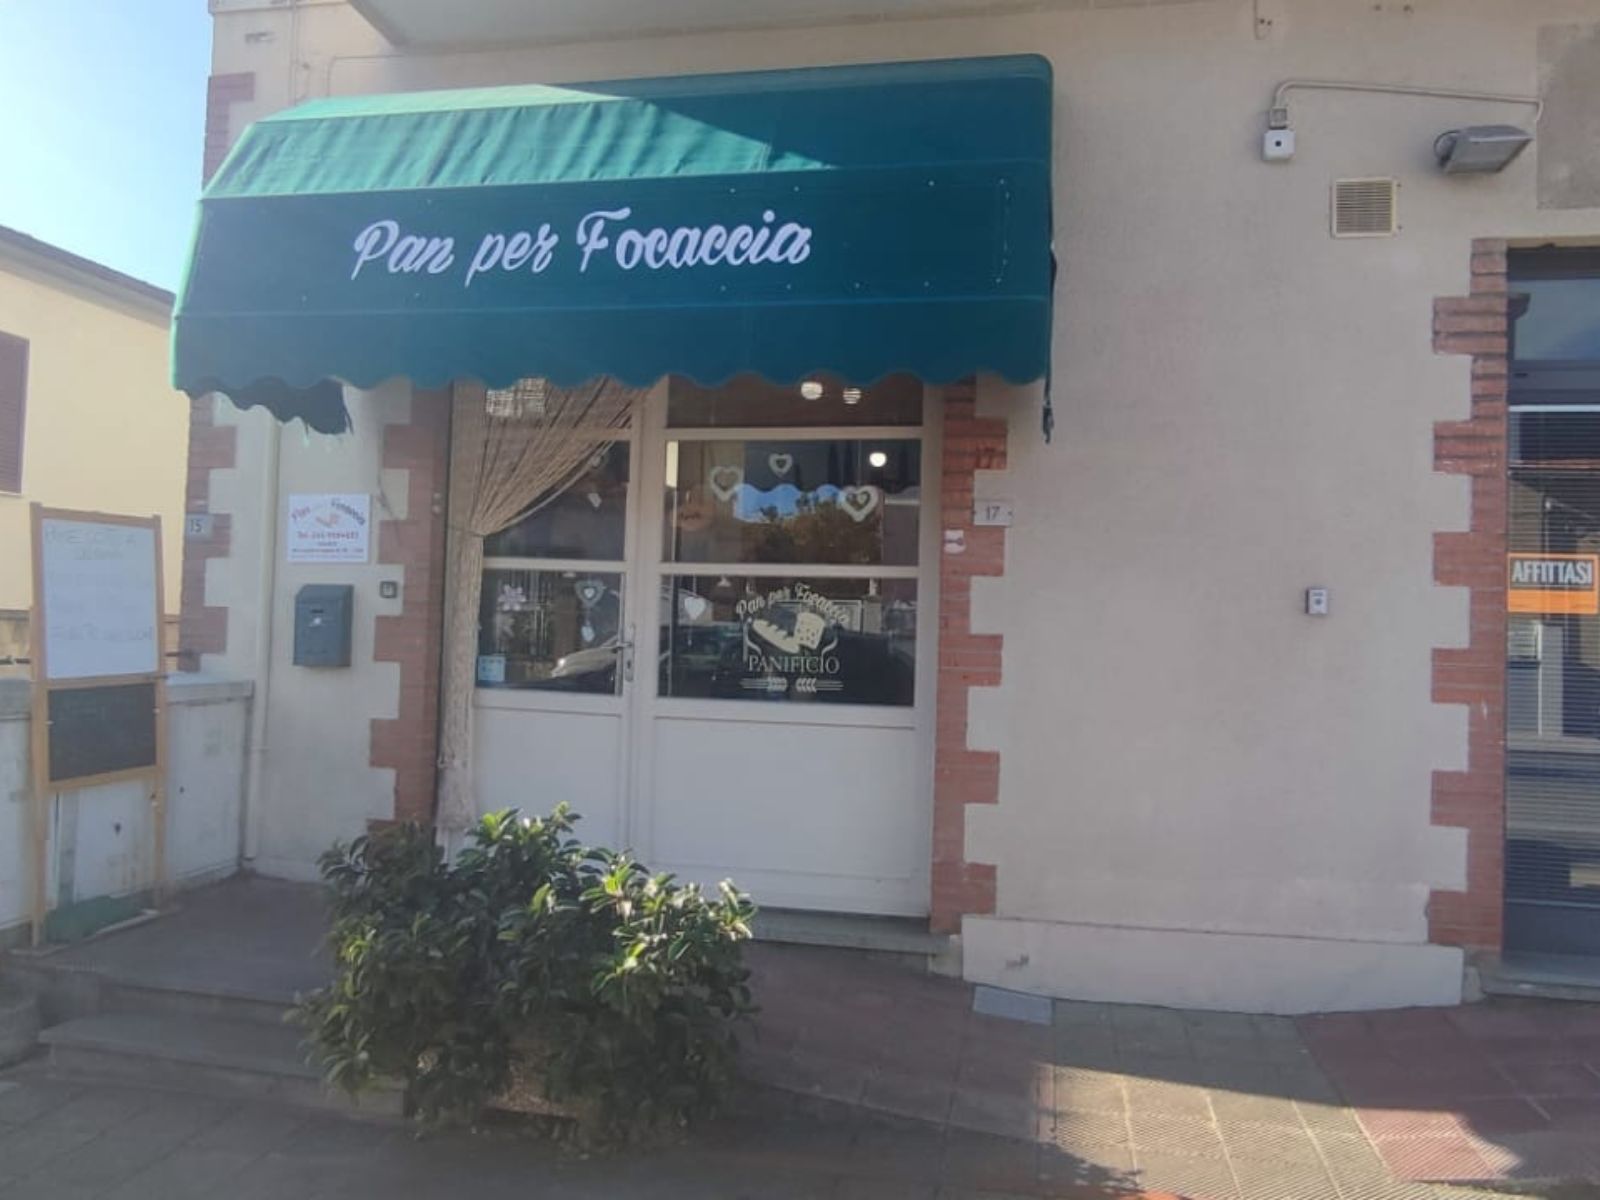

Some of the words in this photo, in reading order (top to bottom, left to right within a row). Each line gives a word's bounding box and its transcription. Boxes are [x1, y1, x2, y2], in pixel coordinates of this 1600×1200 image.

[351, 220, 455, 280] Pan
[465, 223, 559, 287] per
[576, 207, 812, 271] Focaccia
[985, 505, 1001, 521] 17
[189, 518, 204, 533] 15
[1511, 560, 1593, 584] AFFITTASI
[748, 655, 841, 674] PANIFICIO
